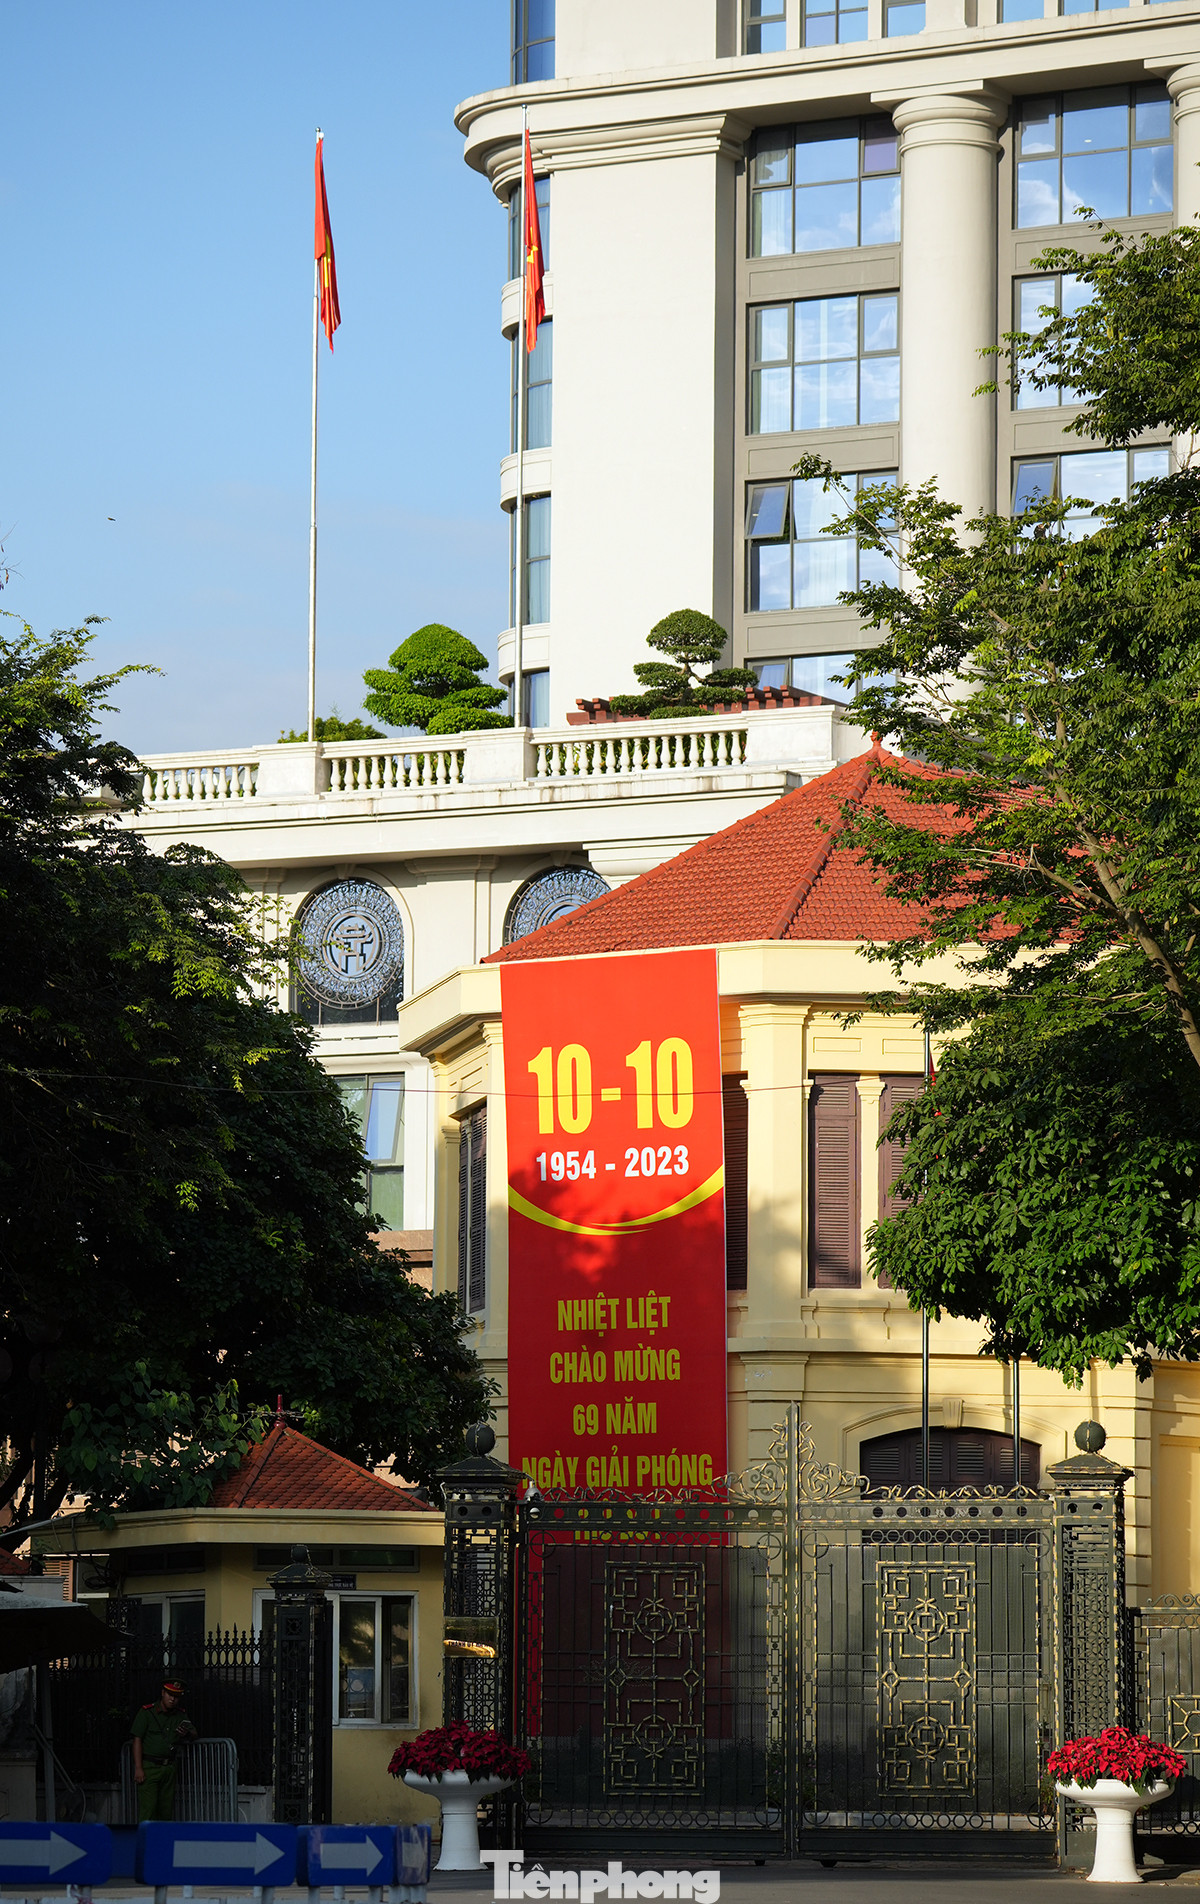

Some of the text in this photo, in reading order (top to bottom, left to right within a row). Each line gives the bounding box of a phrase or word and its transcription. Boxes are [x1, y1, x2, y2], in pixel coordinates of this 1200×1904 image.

[536, 1150, 596, 1181] 1954
[624, 1145, 689, 1177] 2023
[557, 1290, 671, 1337] NHIỆT LIỆT
[550, 1343, 681, 1384] CHÀO MỪNG
[573, 1396, 657, 1435] 69 NĂM
[522, 1445, 712, 1488] NGÀY GIẢI PHÓNG
